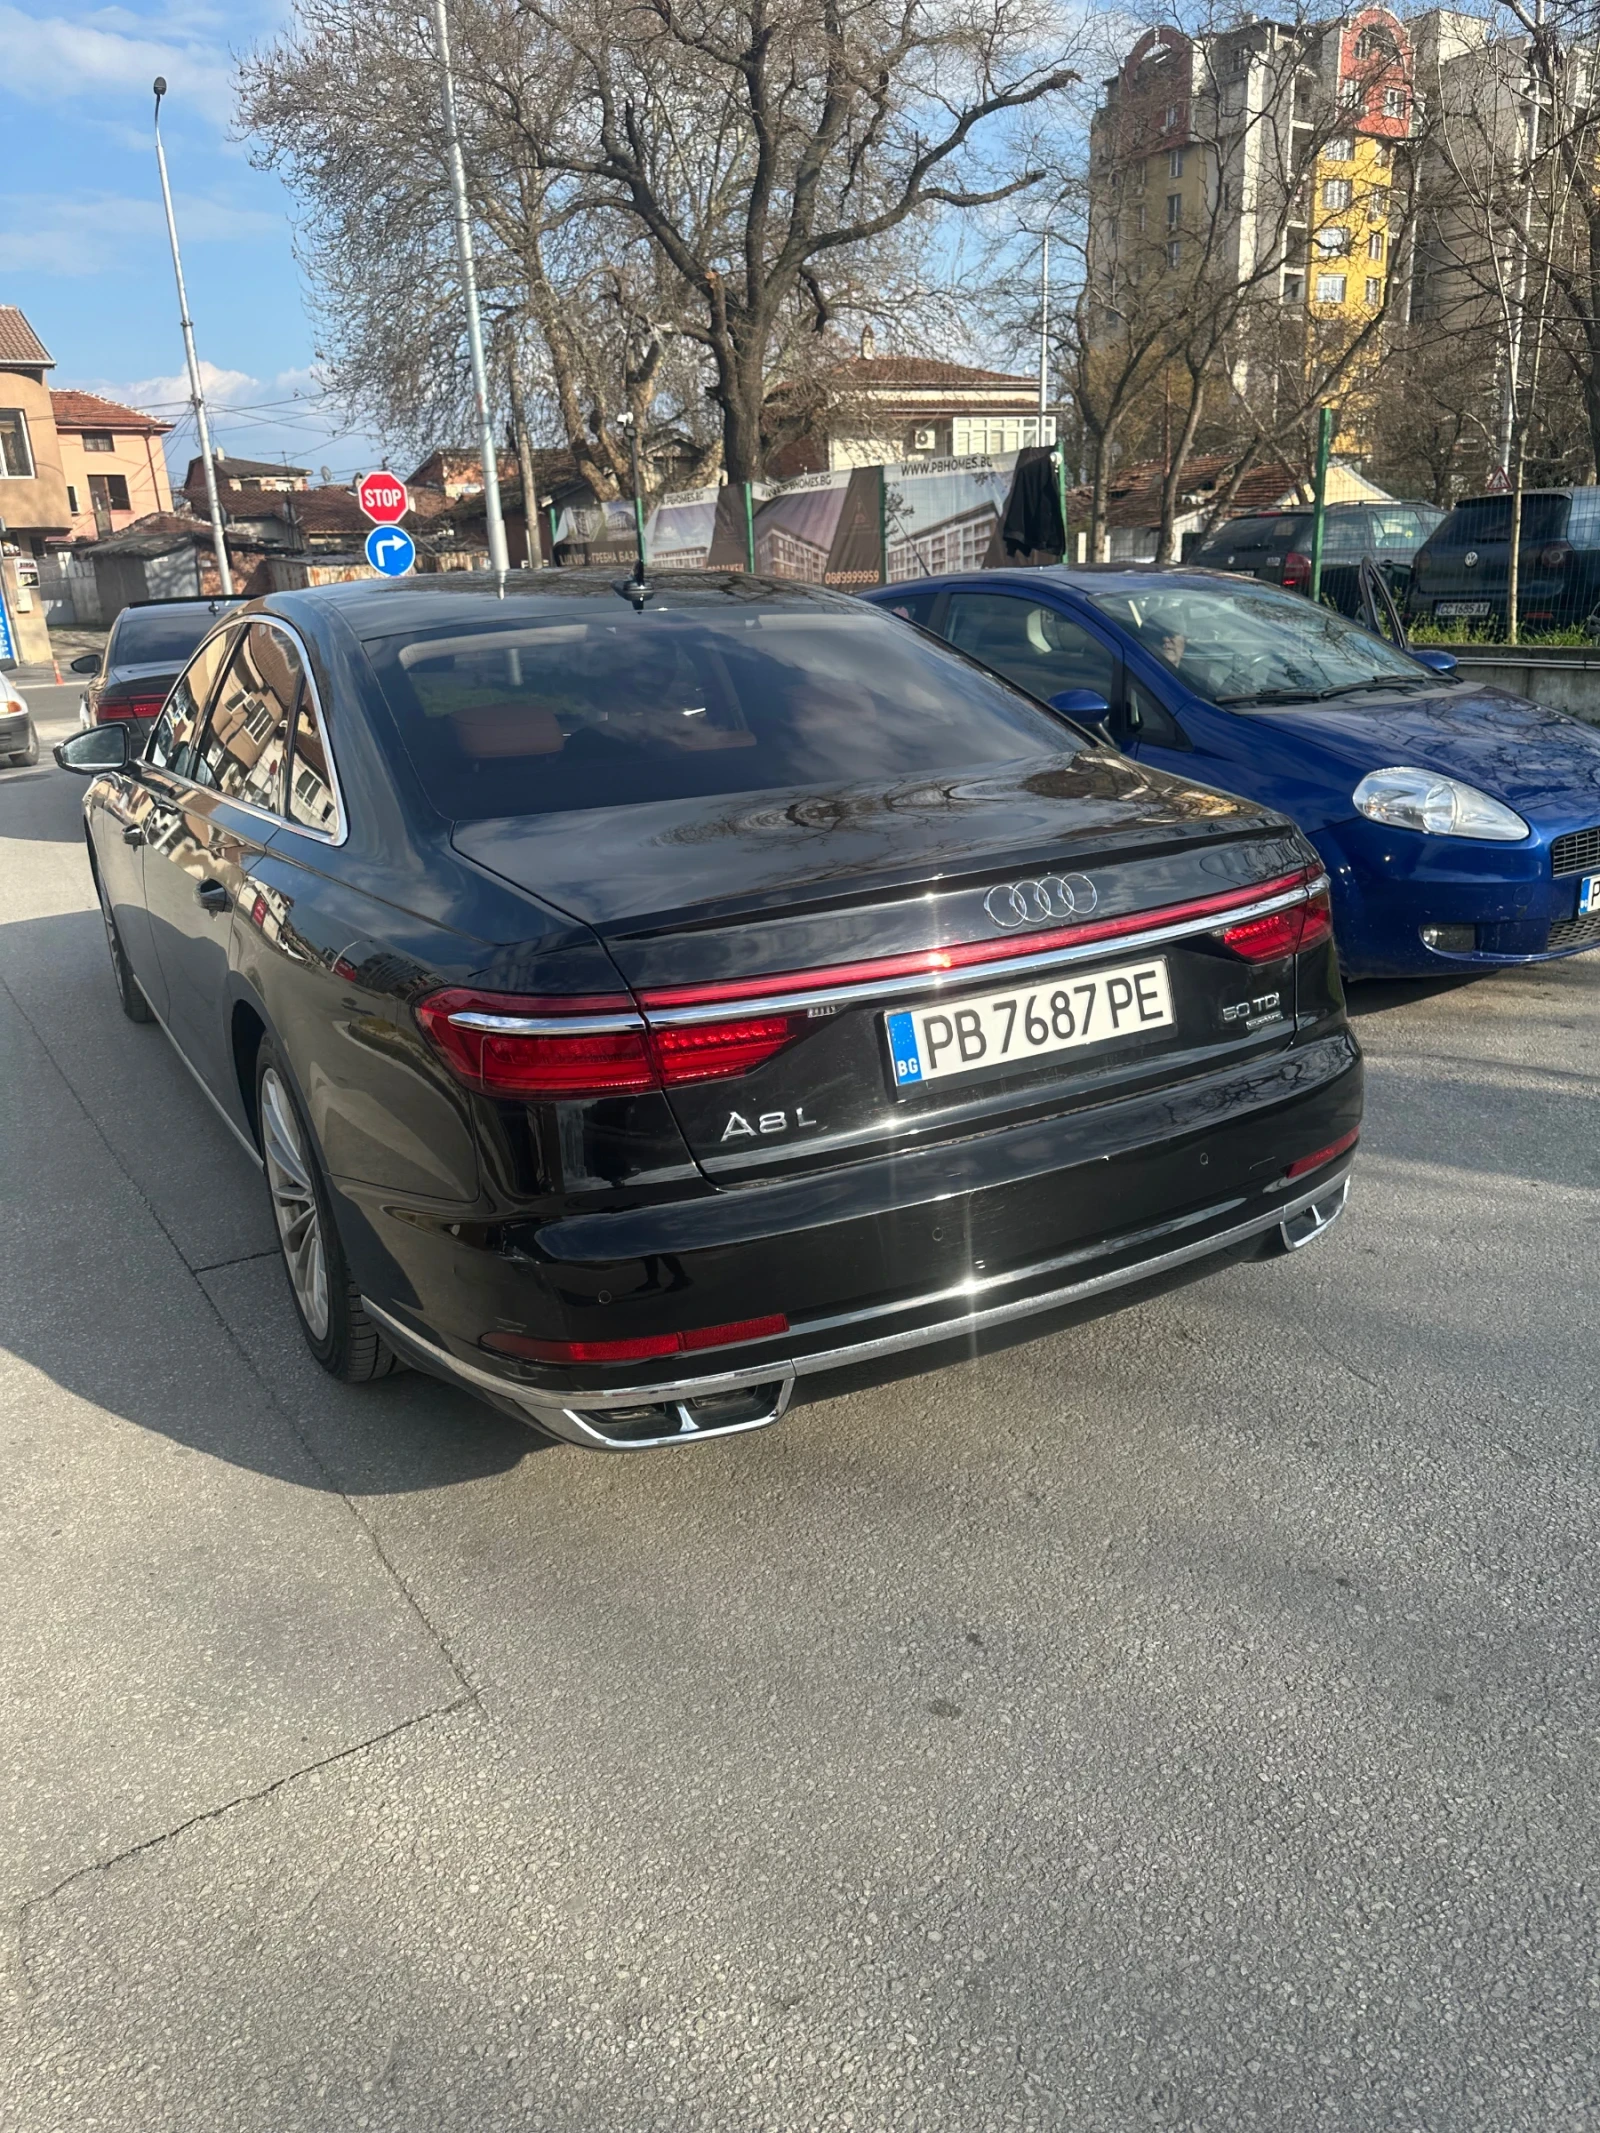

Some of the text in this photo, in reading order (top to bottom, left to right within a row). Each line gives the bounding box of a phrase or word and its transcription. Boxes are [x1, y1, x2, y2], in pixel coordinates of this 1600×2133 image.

[901, 456, 993, 476] WWW.PBHOMES.BG
[364, 488, 402, 507] STOP
[825, 570, 880, 584] 0889999959
[922, 970, 1164, 1070] PB 7687 PE
[1223, 1002, 1250, 1021] 50
[897, 1057, 918, 1077] BG
[721, 1107, 817, 1142] A8 L
